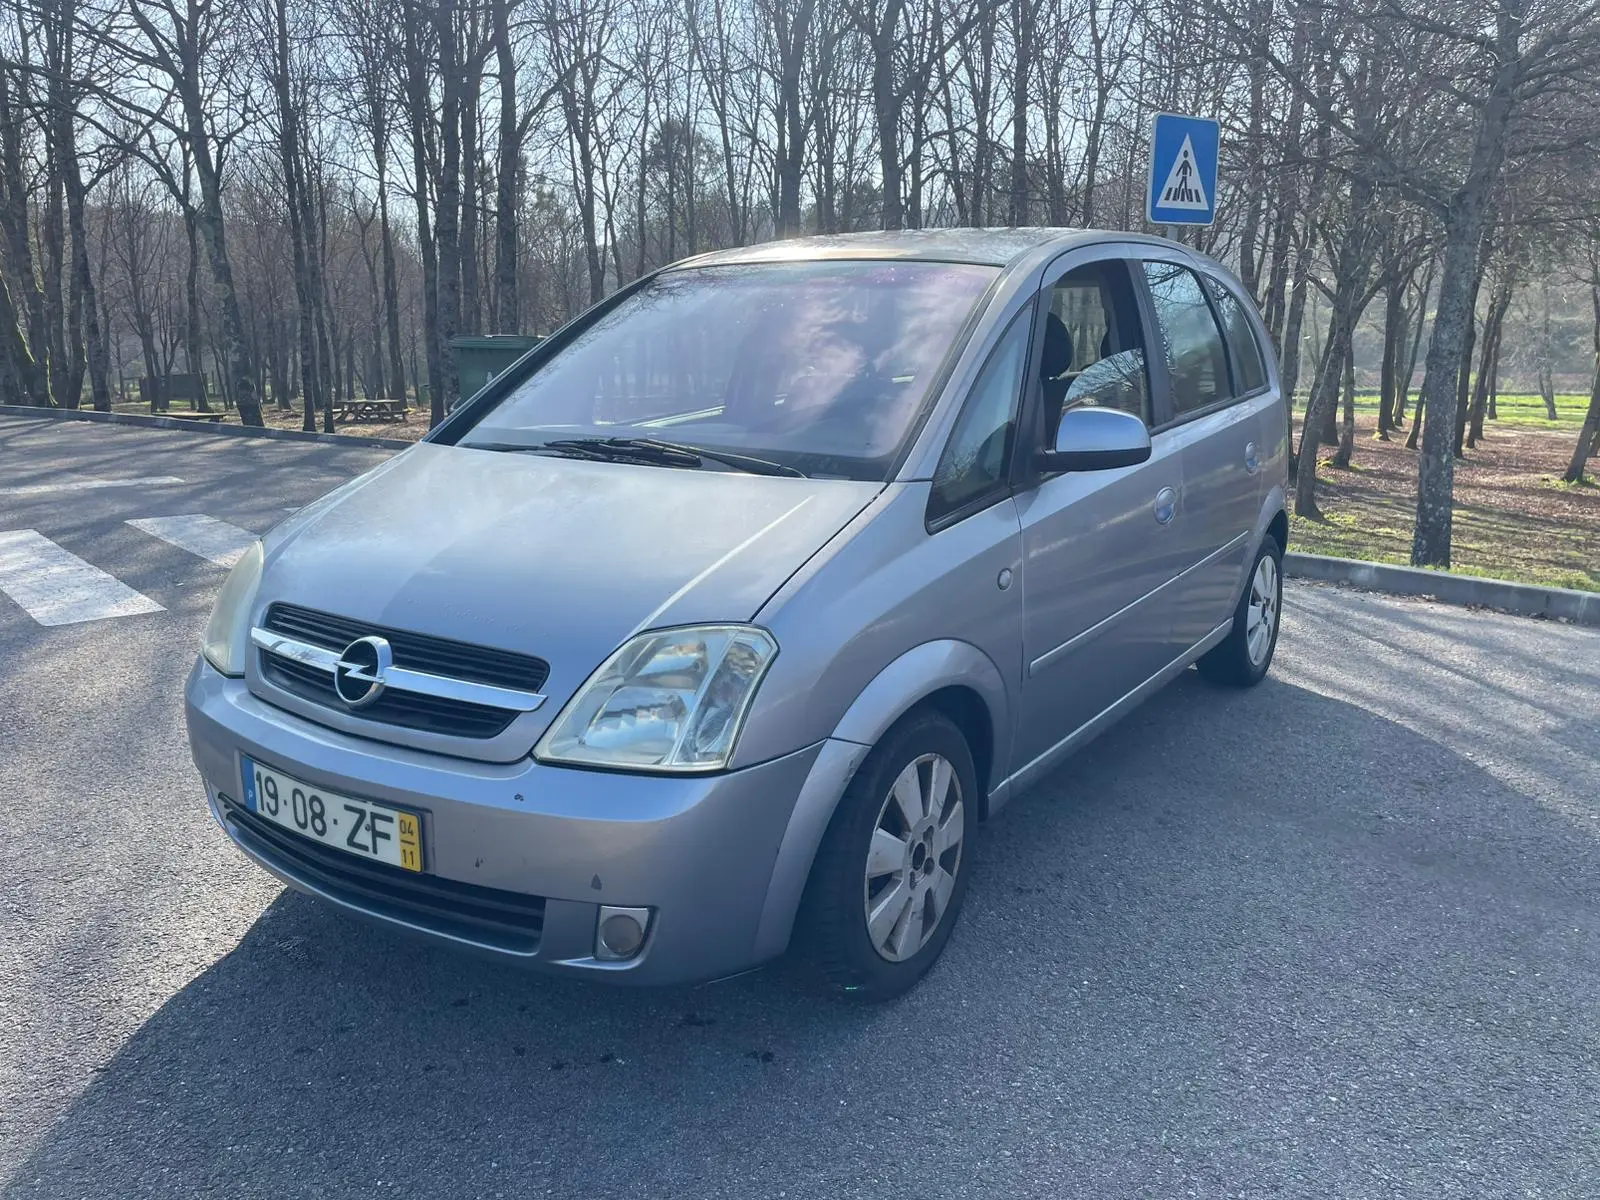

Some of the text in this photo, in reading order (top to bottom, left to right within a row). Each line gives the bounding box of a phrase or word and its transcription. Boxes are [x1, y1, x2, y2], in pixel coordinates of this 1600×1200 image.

[248, 789, 254, 800] P
[400, 819, 414, 836] 04
[402, 849, 415, 866] 11
